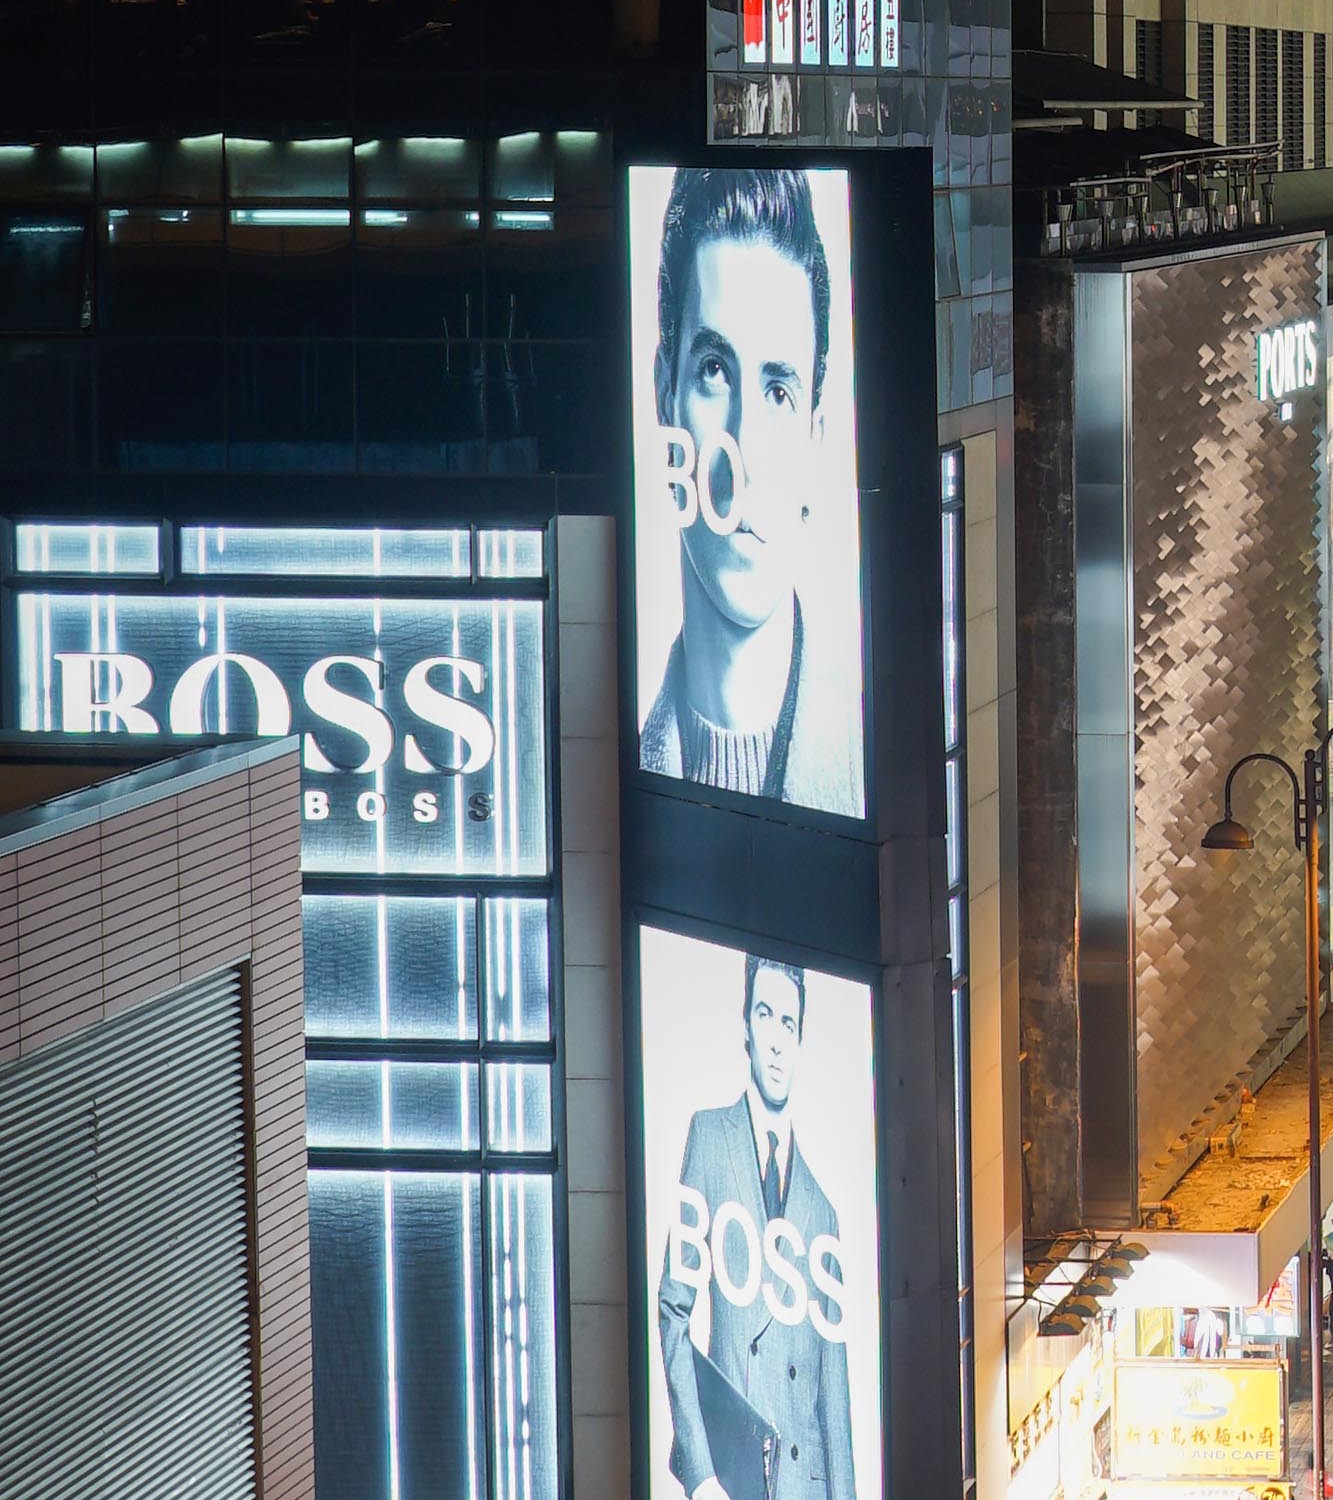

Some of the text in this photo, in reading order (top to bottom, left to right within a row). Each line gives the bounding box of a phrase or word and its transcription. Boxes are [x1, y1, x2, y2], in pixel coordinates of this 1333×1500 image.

[1257, 320, 1317, 401] PORTS
[669, 1182, 849, 1344] BOSS
[1231, 1450, 1275, 1461] CAFE
